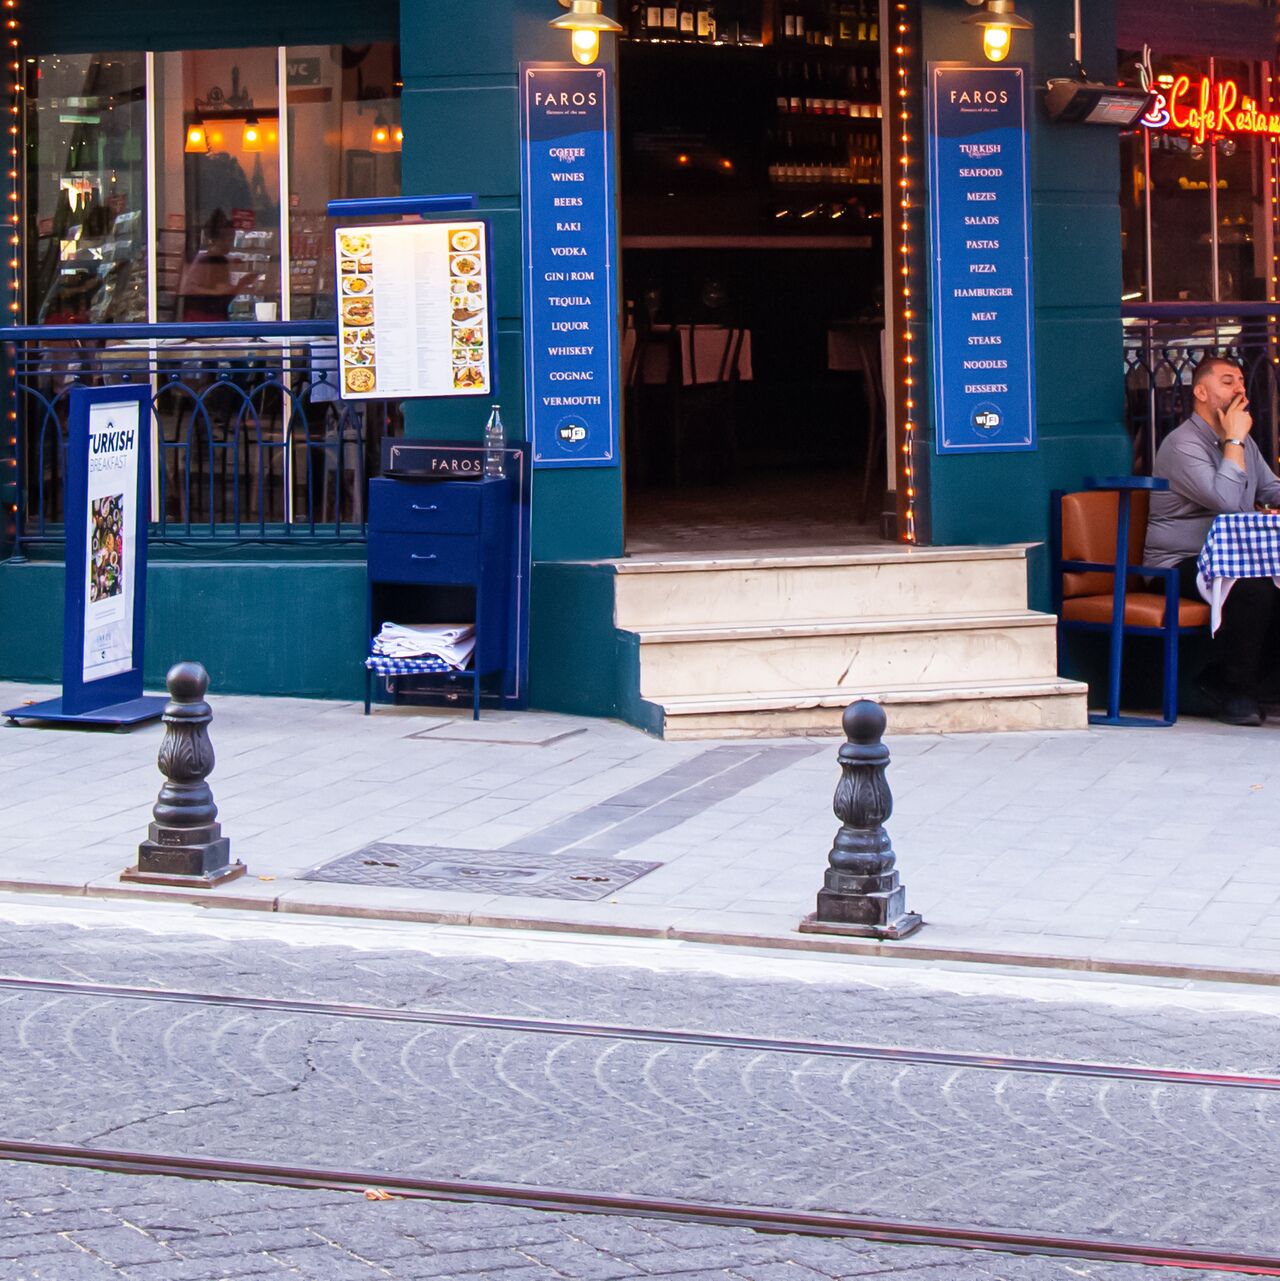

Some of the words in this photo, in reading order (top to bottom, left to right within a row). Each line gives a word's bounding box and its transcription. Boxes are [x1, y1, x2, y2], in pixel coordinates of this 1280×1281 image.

[535, 92, 597, 106] FAROS
[950, 90, 1008, 104] FAROS
[549, 148, 585, 157] COFFEE
[959, 144, 1001, 153] TURKISH
[551, 173, 584, 182] WINES
[959, 169, 1003, 177] SEAFOOD
[967, 192, 996, 201] MEZES
[554, 197, 583, 207] BEERS
[964, 216, 999, 225] SALADS
[556, 222, 581, 231] RAKI
[966, 240, 999, 249] PASTAS
[551, 247, 587, 256] VODKA
[969, 264, 996, 273] PIZZA
[544, 272, 564, 281] GIN
[571, 272, 594, 280] ROM
[954, 288, 1013, 297] HAMBURGER
[548, 297, 591, 307] TEQUILA
[971, 312, 997, 321] MEAT
[551, 321, 589, 331] LIQUOR
[968, 336, 1002, 345] STEAKS
[548, 346, 594, 356] WHISKEY
[963, 360, 1008, 369] NOODLES
[549, 371, 594, 380] COGNAC
[965, 384, 1008, 394] DESSERTS
[543, 396, 601, 406] VERMOUTH
[90, 454, 128, 472] BREAKFAST
[431, 458, 481, 471] FAROS
